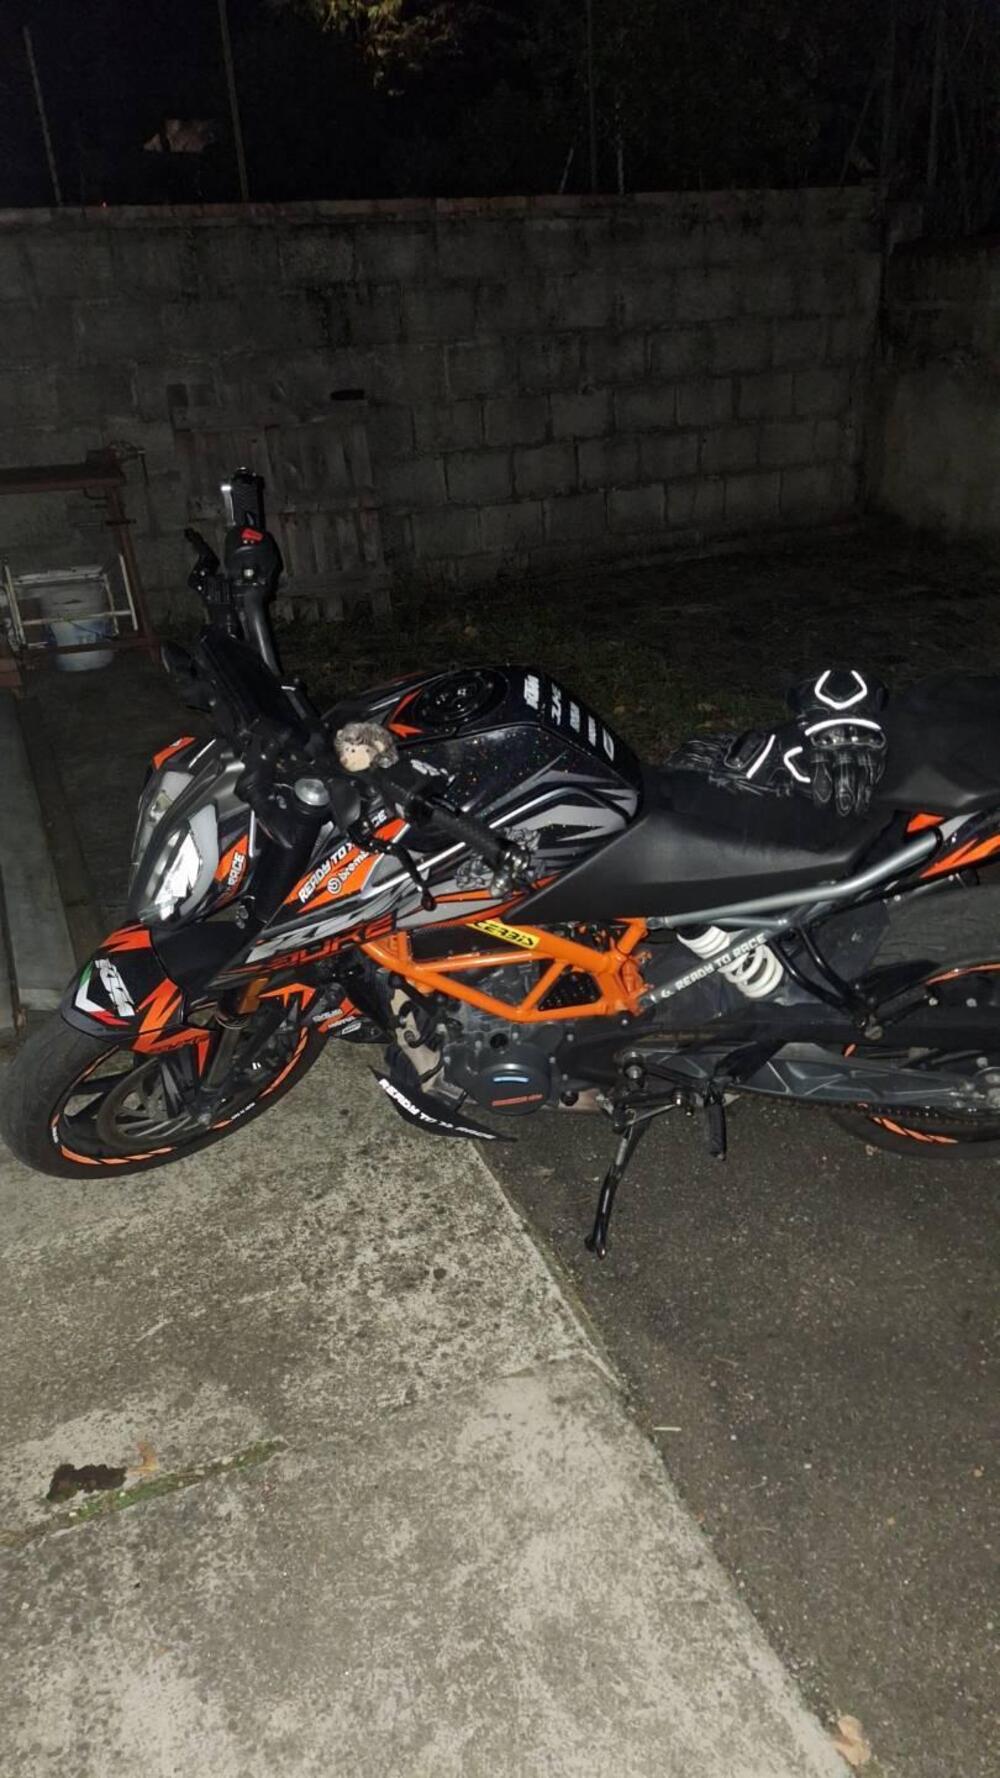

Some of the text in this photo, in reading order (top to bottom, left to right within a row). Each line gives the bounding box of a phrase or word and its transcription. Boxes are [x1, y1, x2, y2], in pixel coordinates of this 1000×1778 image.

[298, 859, 332, 904] READY
[674, 932, 767, 990] READY TO RACE
